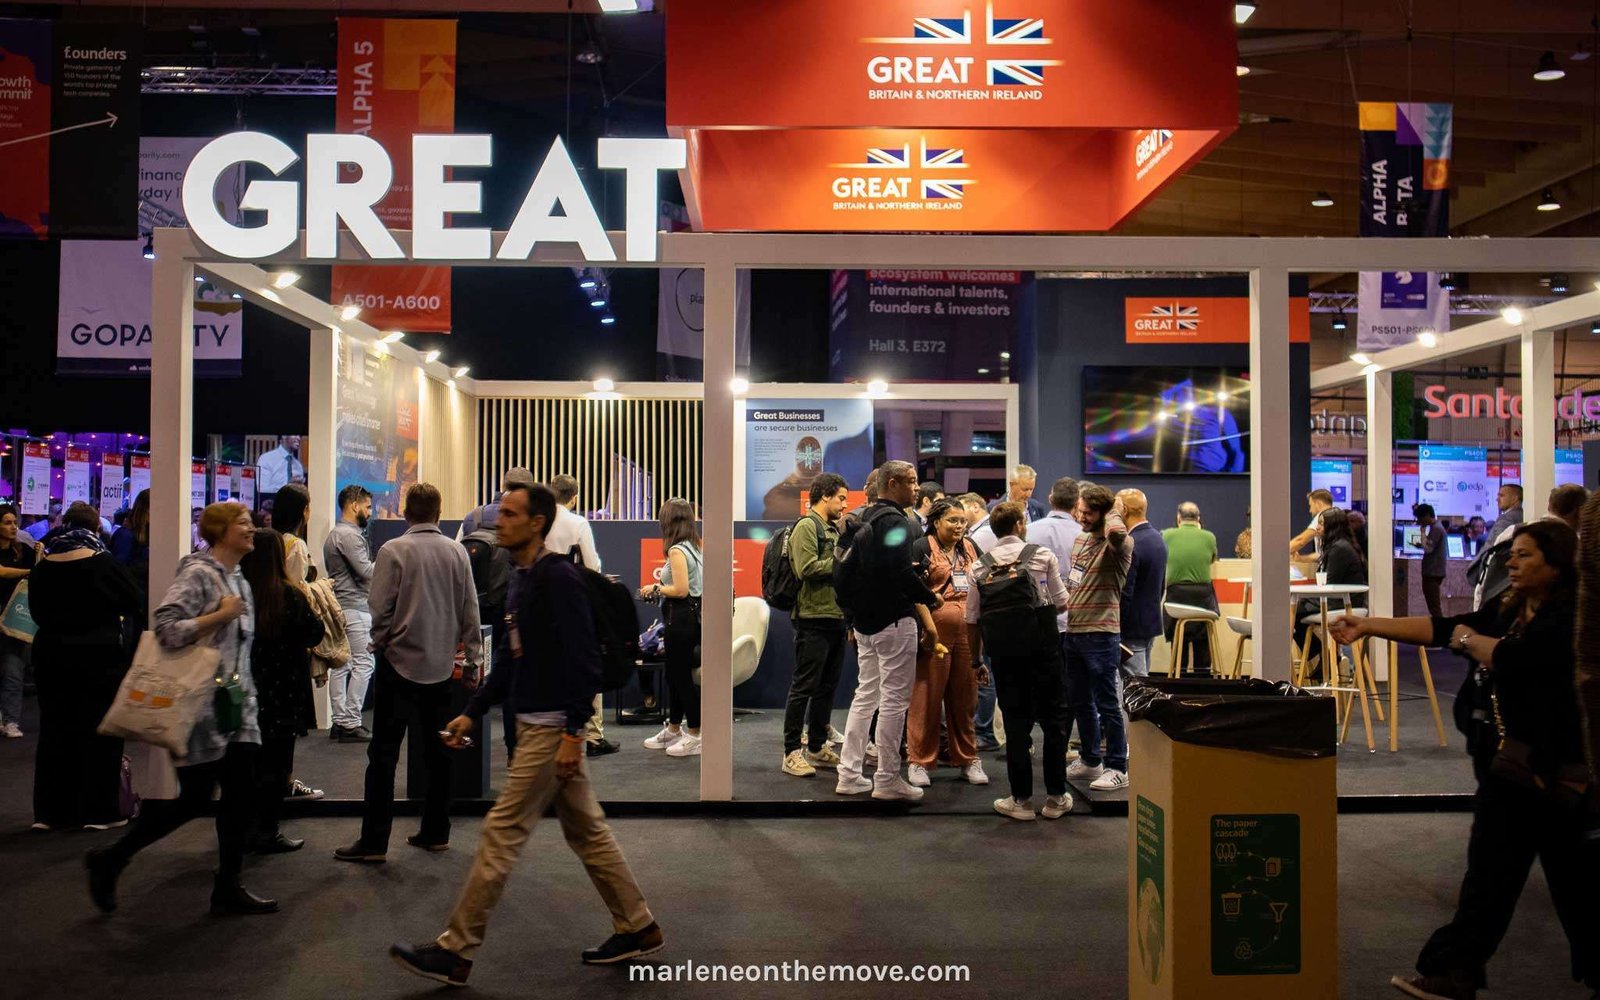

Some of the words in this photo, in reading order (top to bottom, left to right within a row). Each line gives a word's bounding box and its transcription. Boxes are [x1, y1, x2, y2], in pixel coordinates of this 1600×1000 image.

[64, 46, 127, 60] f.ounders
[354, 40, 374, 56] 5
[867, 56, 973, 84] GREAT
[352, 61, 374, 136] ALPHA
[868, 89, 913, 100] BRITAIN
[915, 90, 925, 100] &
[926, 90, 990, 100] NORTHERN
[992, 90, 1043, 101] IRELAND
[139, 168, 183, 181] inanc
[831, 177, 912, 199] GREAT
[1371, 159, 1388, 225] ALPHA
[182, 130, 687, 262] GREAT
[833, 202, 867, 211] BRITAIN
[868, 202, 875, 210] &
[876, 202, 923, 211] NORTHERN
[925, 202, 963, 211] IRELAND
[870, 269, 944, 282] ecosystem
[947, 270, 1015, 282] welcomes
[869, 284, 955, 297] international
[959, 286, 1009, 299] talents,
[342, 294, 440, 311] A501-A600
[869, 300, 931, 314] founders
[934, 302, 945, 314] &
[949, 303, 1011, 316] investors
[1134, 319, 1173, 331] GREAT
[70, 323, 230, 347] GOPATY
[869, 339, 894, 352] Hall
[913, 340, 947, 353] E372
[753, 411, 777, 420] Great
[778, 411, 821, 420] Businesses
[796, 424, 838, 432] businesses
[1215, 818, 1232, 828] The
[1234, 820, 1258, 829] paper
[1215, 829, 1249, 838] cascade
